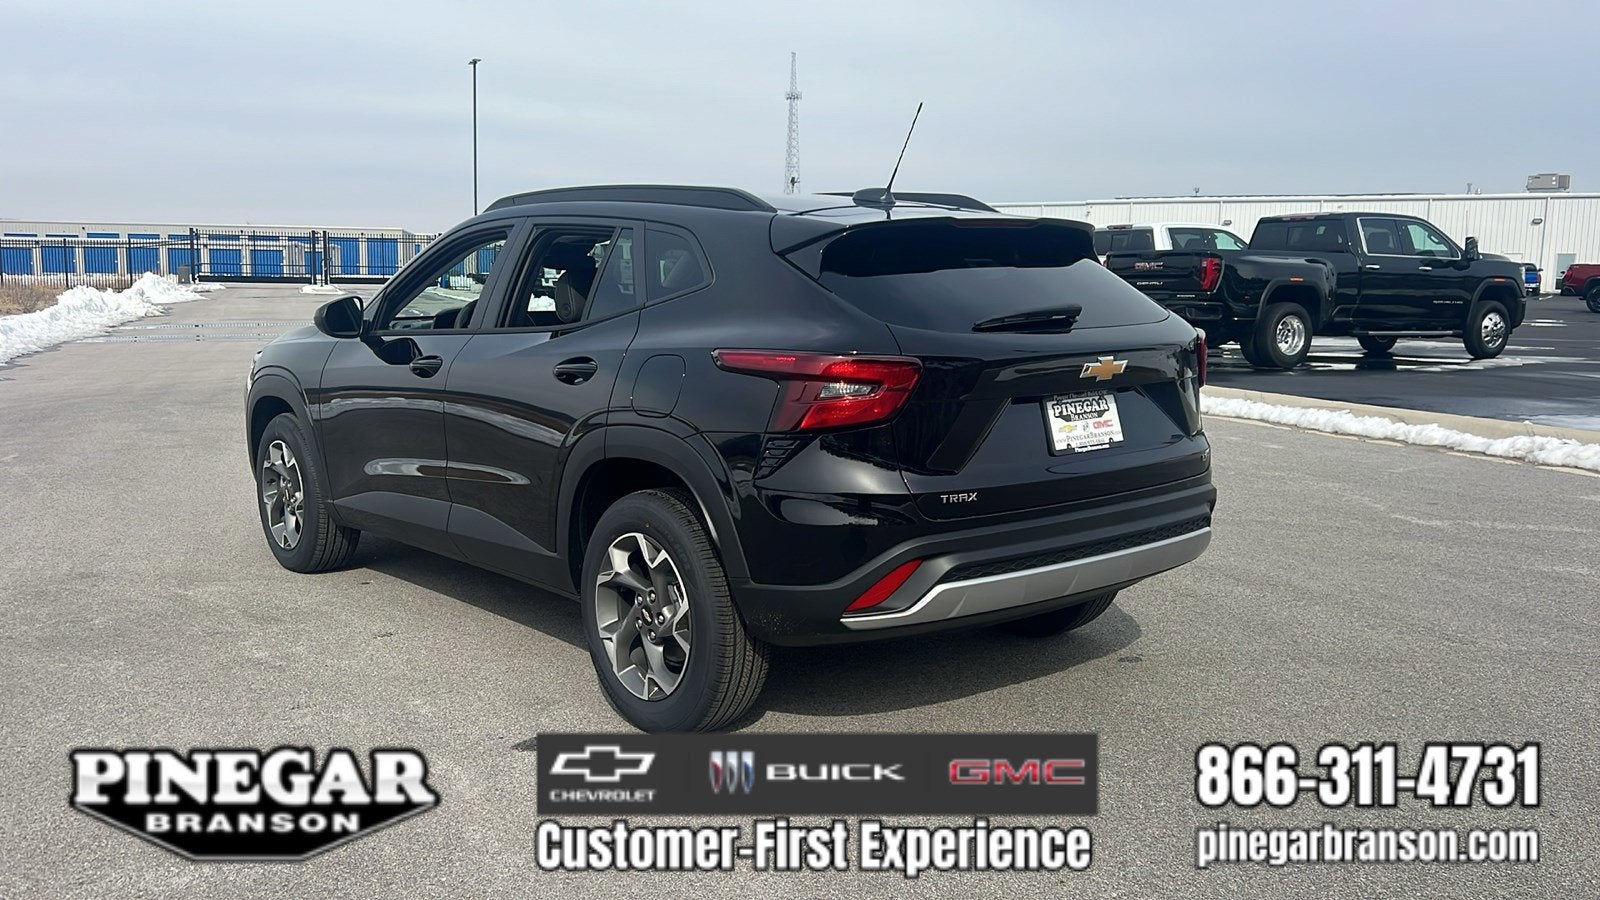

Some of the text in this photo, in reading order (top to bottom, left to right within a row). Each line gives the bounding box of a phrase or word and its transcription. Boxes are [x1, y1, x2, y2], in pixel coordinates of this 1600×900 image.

[1053, 399, 1109, 417] PINEGAR
[1070, 412, 1099, 422] BRANSON
[1093, 420, 1114, 429] GMC
[940, 492, 978, 504] TRAX
